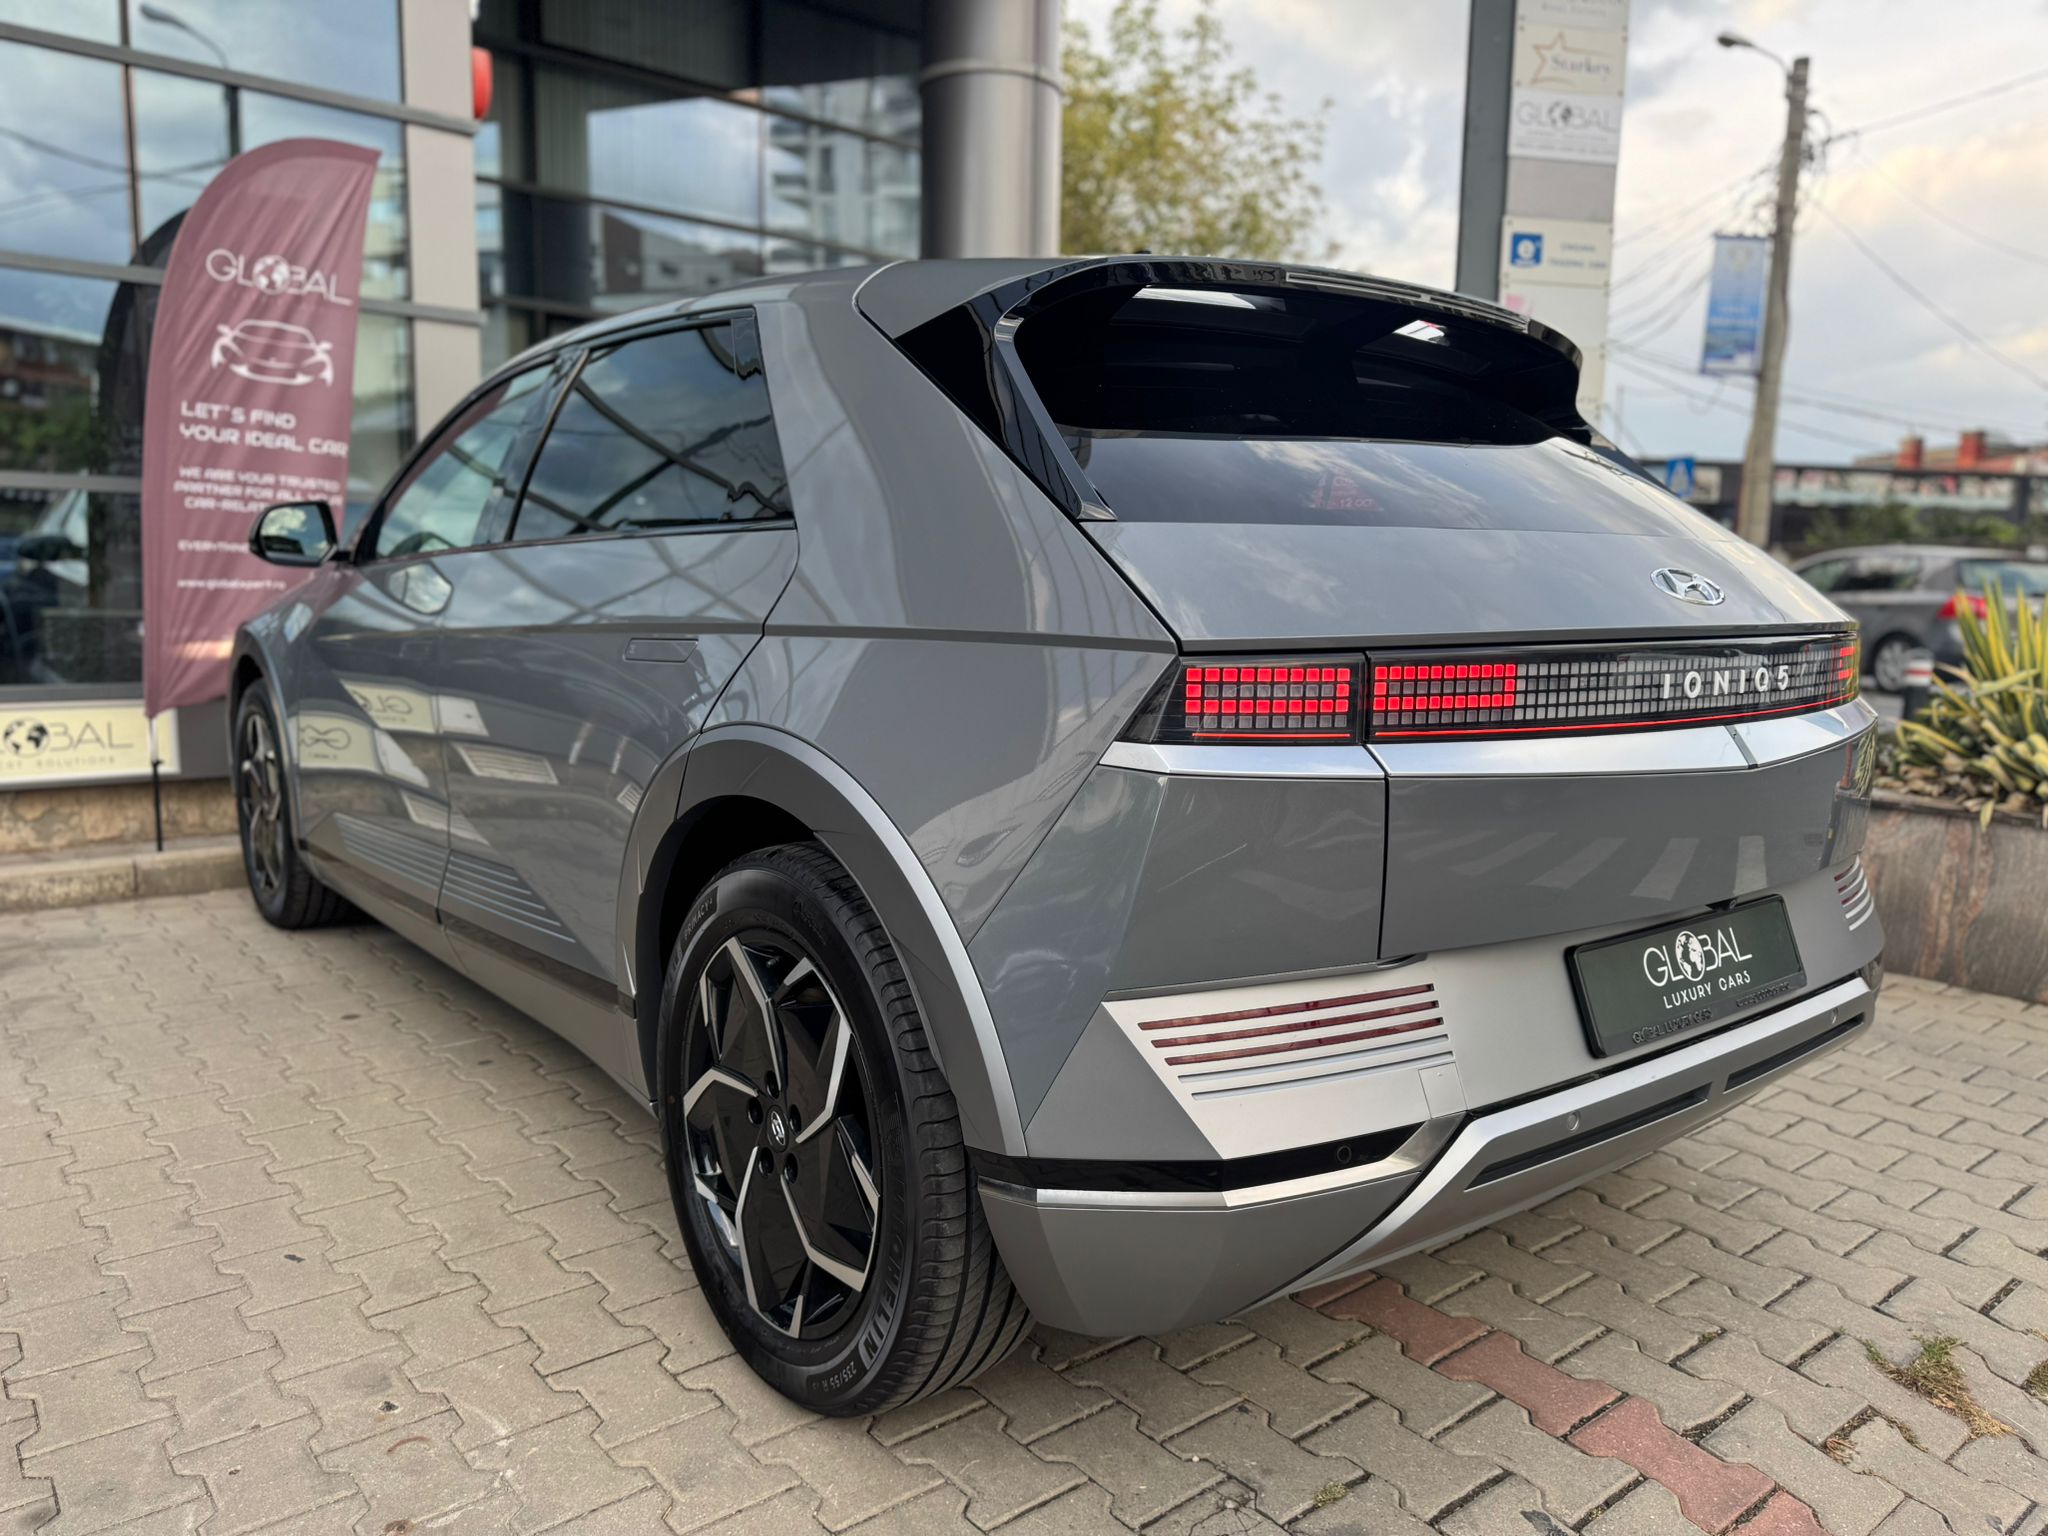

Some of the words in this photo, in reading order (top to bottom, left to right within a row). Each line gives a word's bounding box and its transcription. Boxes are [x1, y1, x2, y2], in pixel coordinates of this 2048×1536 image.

[1516, 100, 1619, 132] GLOBAL
[205, 248, 353, 306] GLOBAL
[250, 410, 297, 429] FIND
[179, 424, 241, 444] YOUR
[245, 432, 304, 453] IDEAL
[308, 438, 349, 459] CAR
[173, 480, 242, 496] PARTNER
[245, 486, 274, 500] FOR
[277, 489, 303, 501] ALL
[179, 466, 202, 478] WE
[204, 469, 235, 482] ARE
[238, 472, 276, 486] YOUR
[279, 475, 340, 492] TRUSTED
[184, 496, 269, 512] CAR-RELAT
[1643, 927, 1753, 988] GLOBAL
[1663, 982, 1713, 1010] LUXURY
[1718, 969, 1752, 992] CARS
